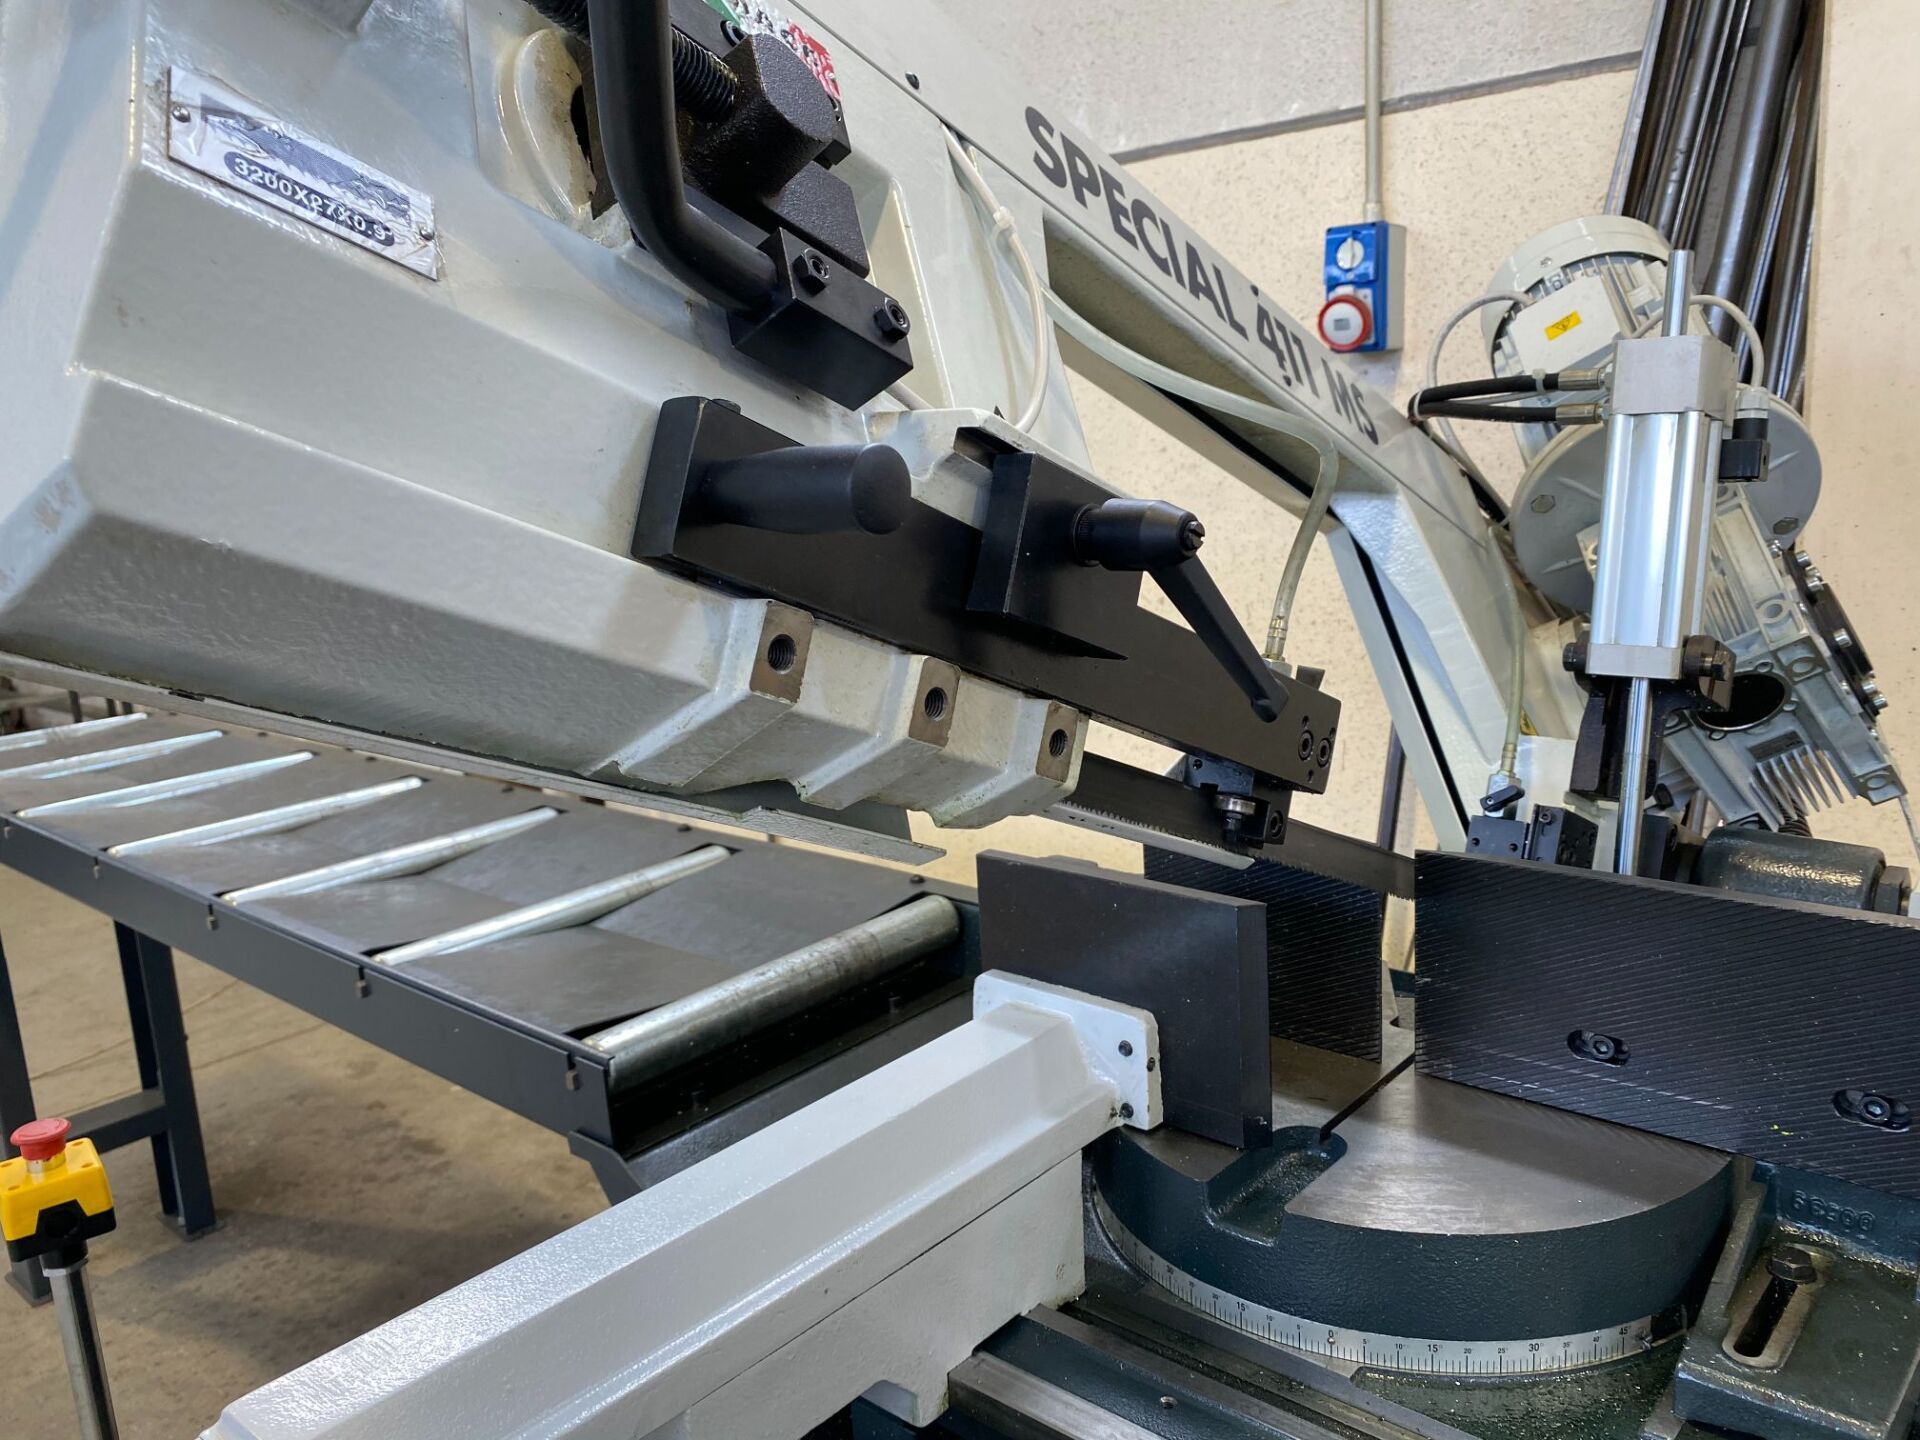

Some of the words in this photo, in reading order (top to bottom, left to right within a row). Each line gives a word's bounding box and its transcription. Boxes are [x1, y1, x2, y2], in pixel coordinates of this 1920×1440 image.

[1024, 105, 1250, 342] SPECIAL
[1256, 307, 1320, 398] 411
[1321, 357, 1379, 446] MS
